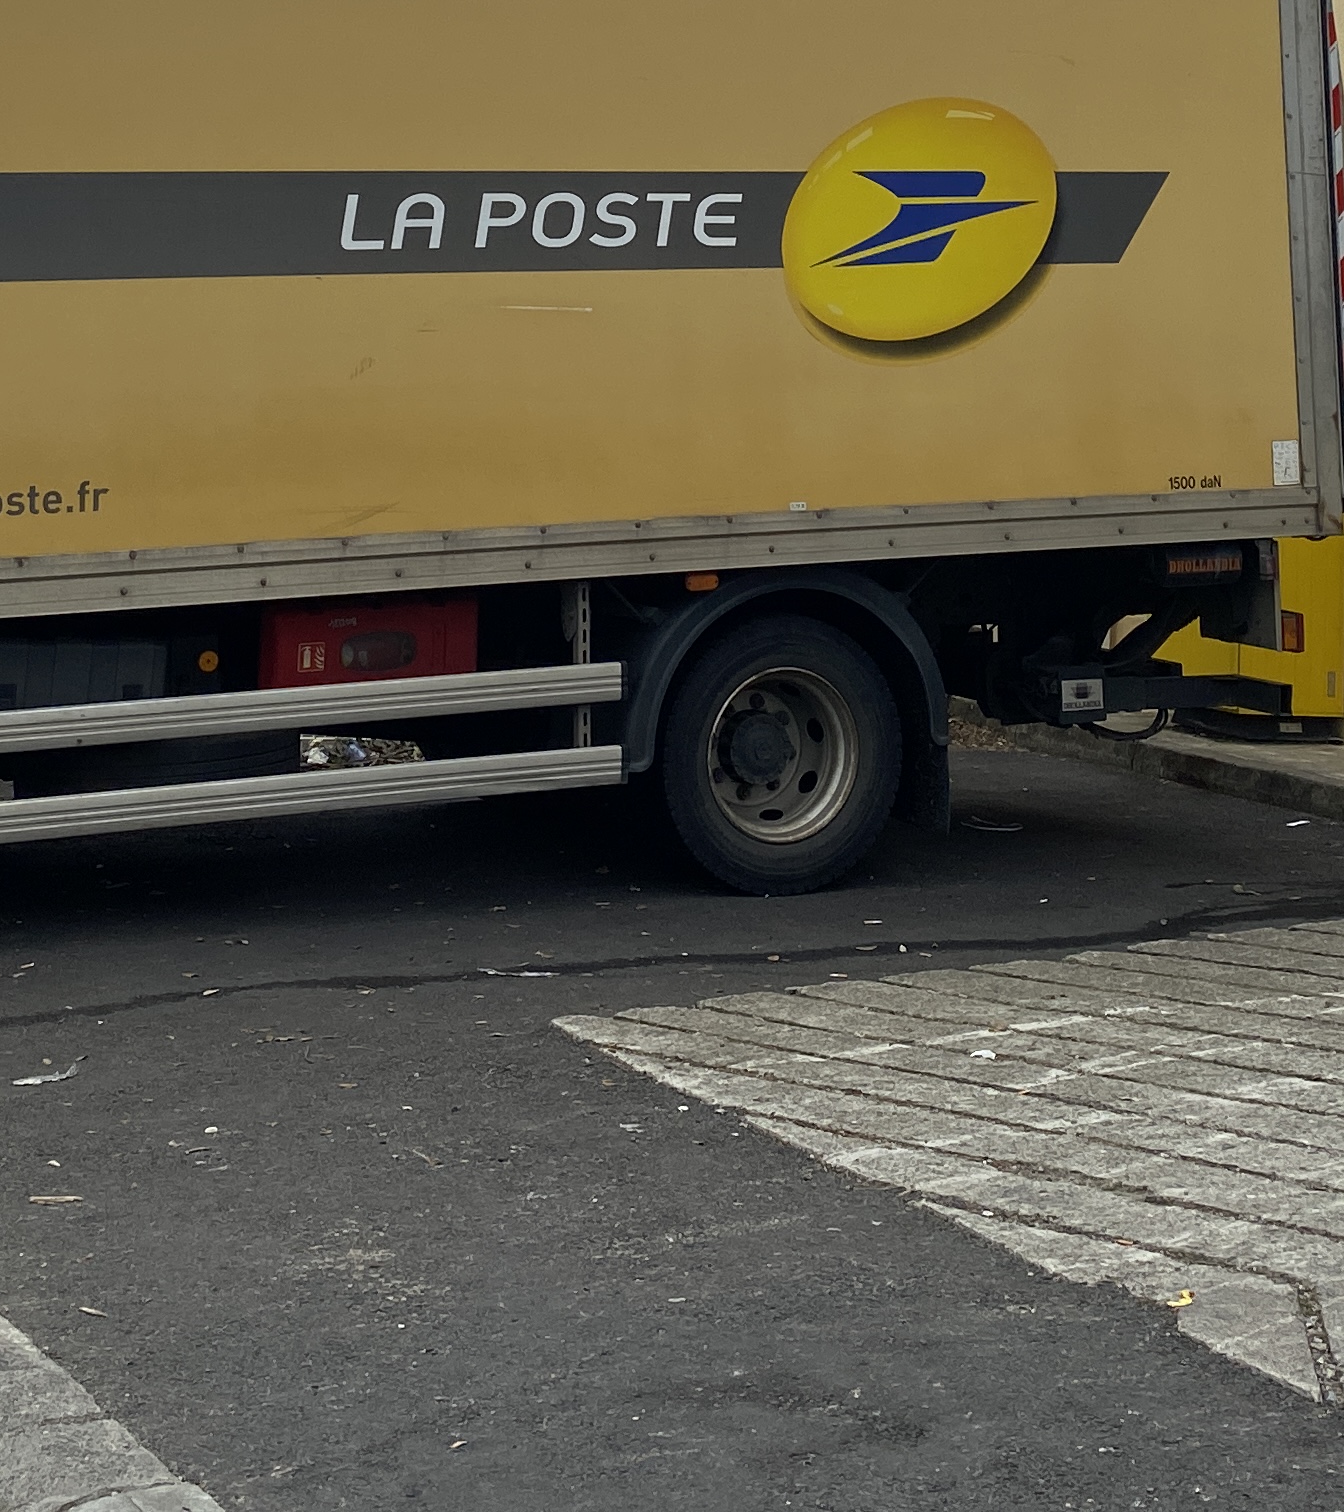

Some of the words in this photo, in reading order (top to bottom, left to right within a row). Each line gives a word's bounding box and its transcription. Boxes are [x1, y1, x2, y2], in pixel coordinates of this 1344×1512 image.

[340, 192, 446, 251] LA
[474, 192, 743, 249] POSTE
[1168, 475, 1196, 490] 1500
[1200, 475, 1222, 489] daN
